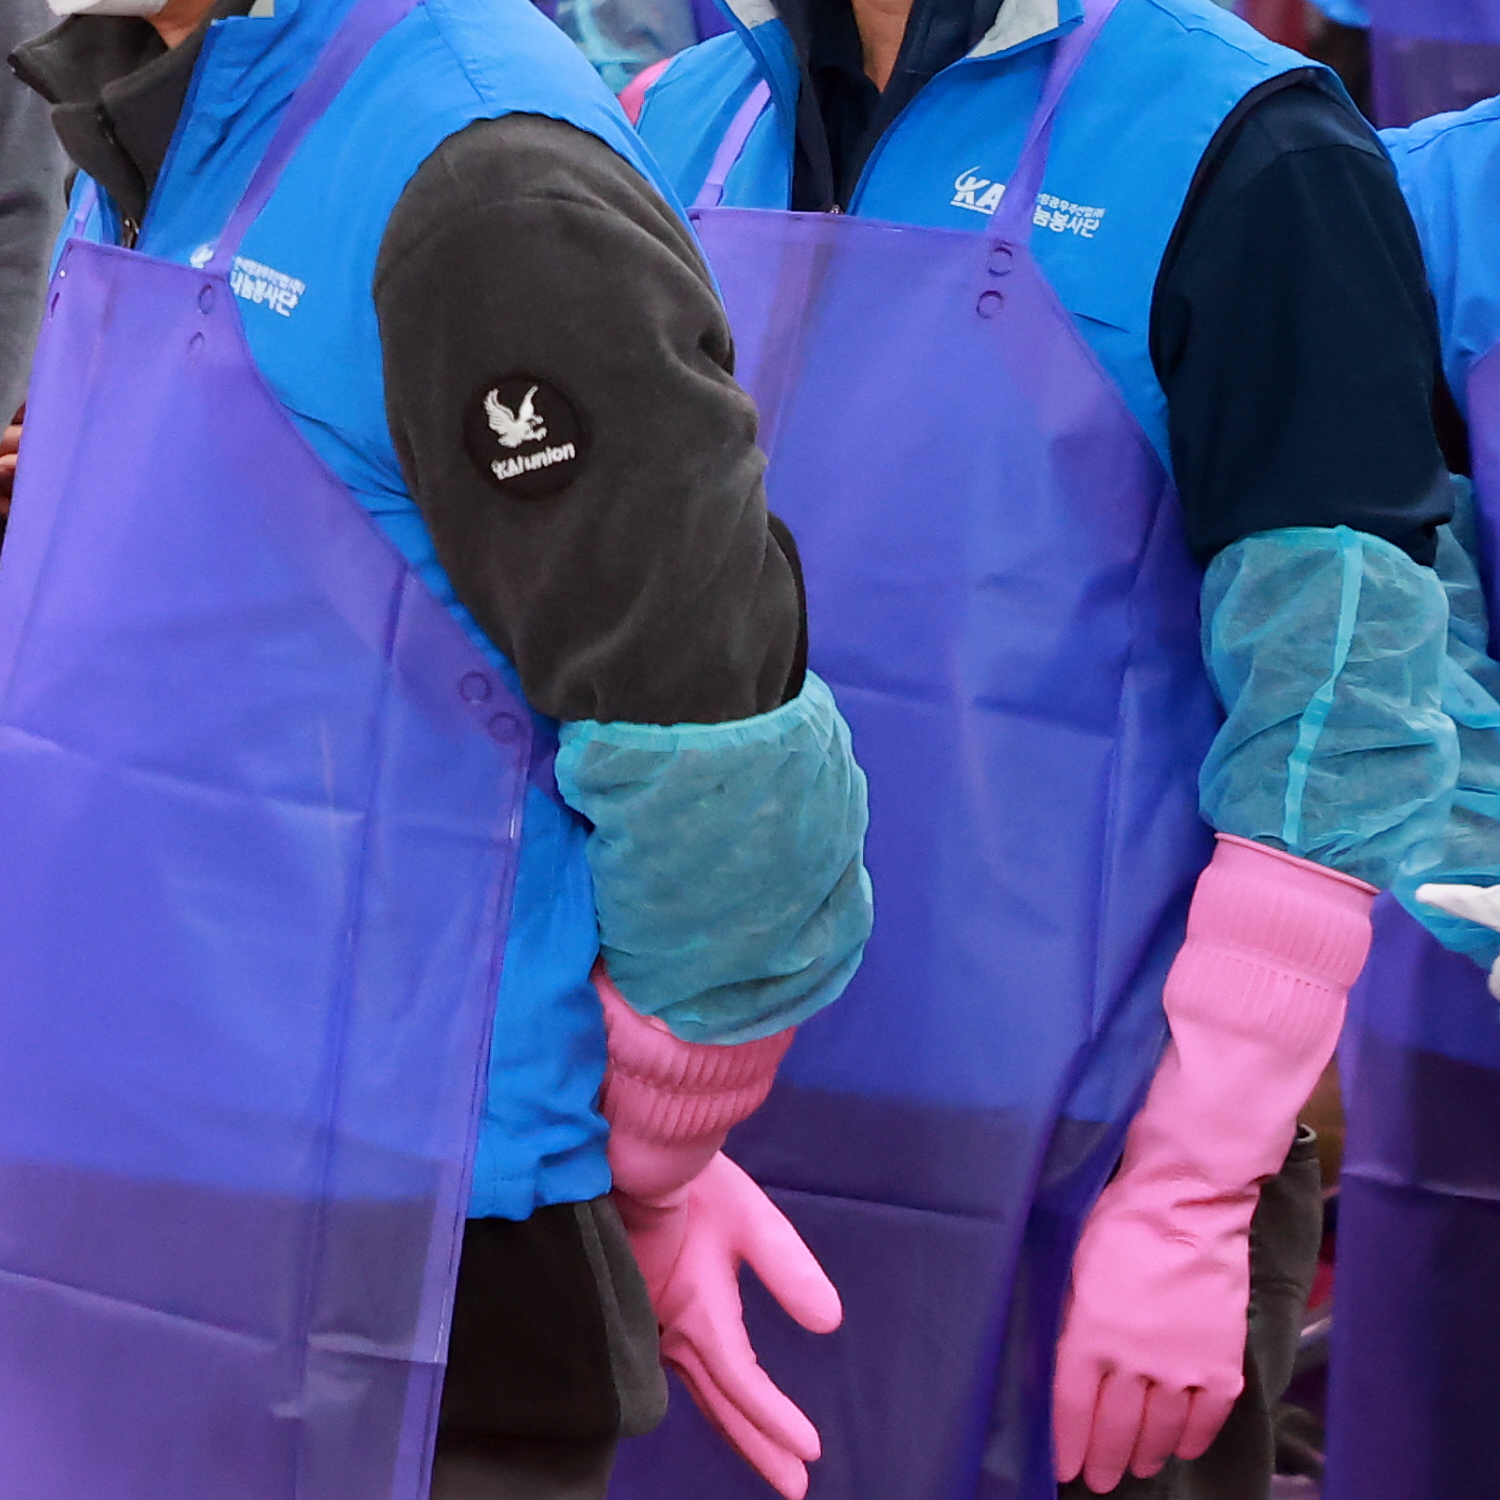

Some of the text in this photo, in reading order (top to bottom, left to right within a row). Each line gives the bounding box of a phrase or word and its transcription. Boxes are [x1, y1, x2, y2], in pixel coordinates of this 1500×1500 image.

[951, 165, 1006, 214] KA
[1033, 205, 1100, 238] 눔봉사단
[523, 442, 576, 471] union
